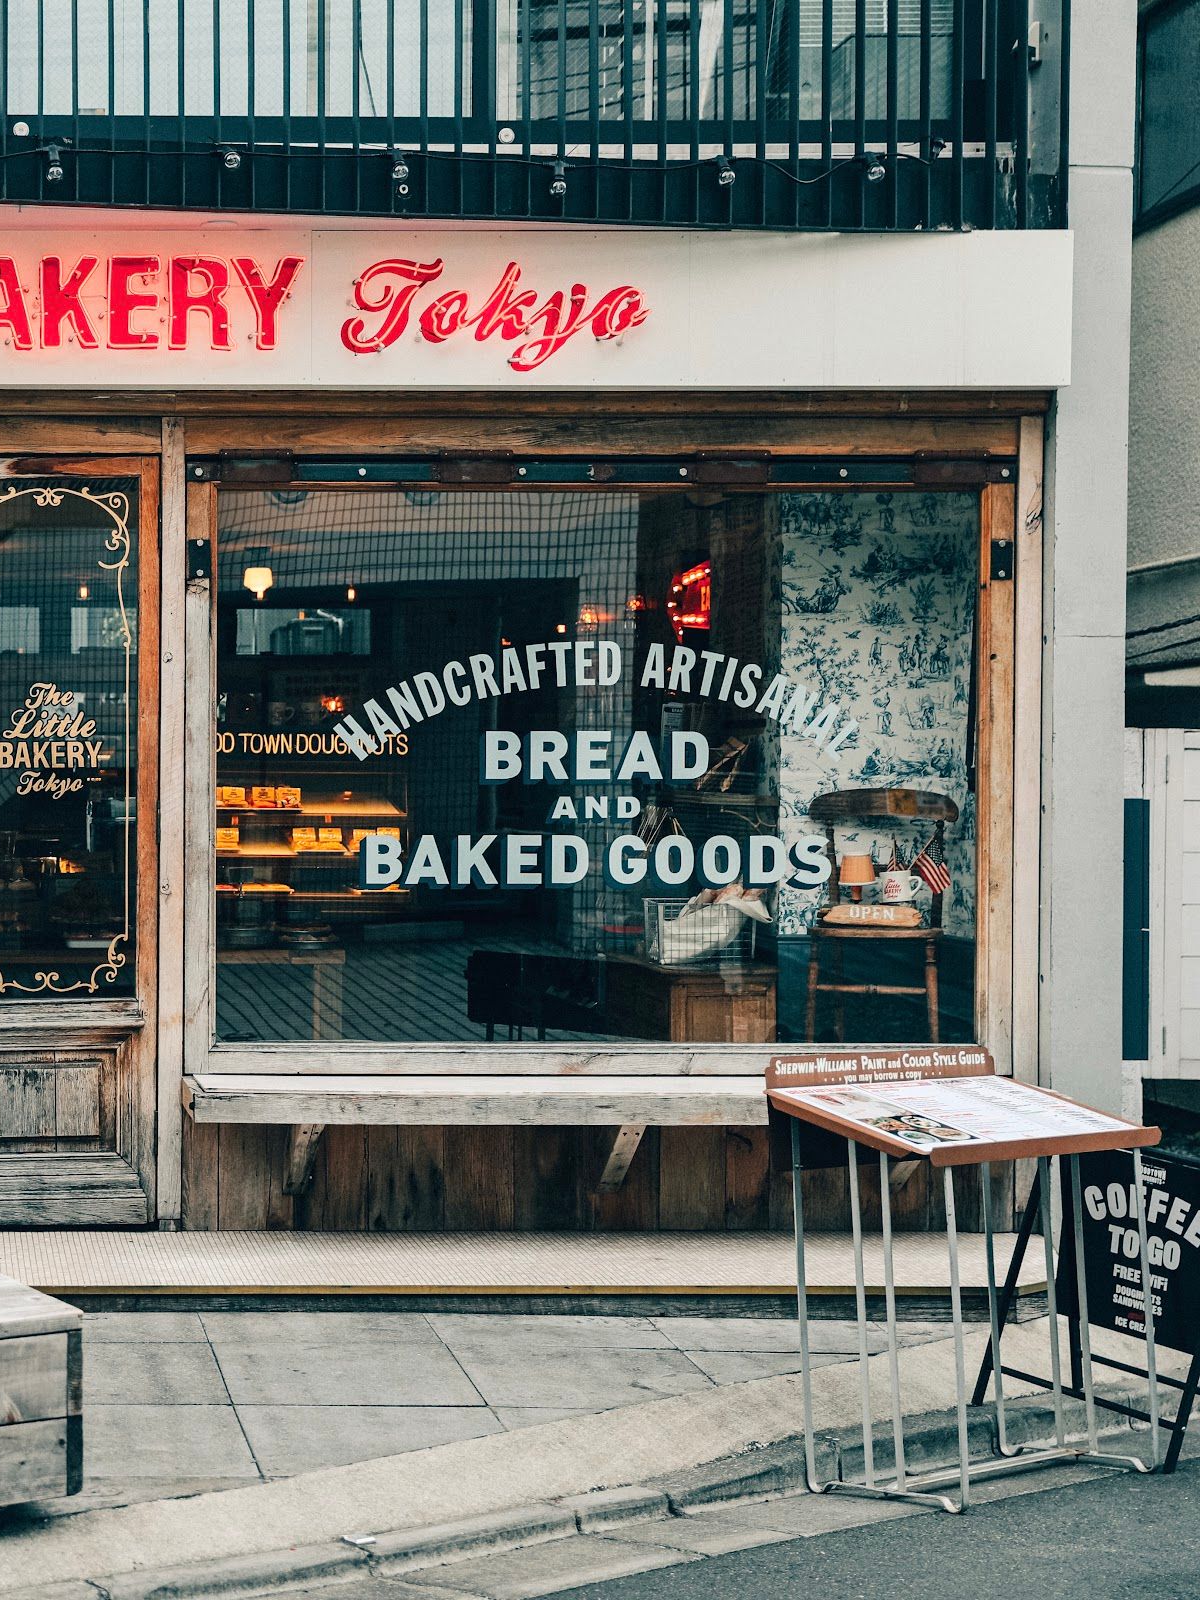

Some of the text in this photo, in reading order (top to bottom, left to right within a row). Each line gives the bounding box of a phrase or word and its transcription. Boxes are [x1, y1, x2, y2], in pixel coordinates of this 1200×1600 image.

[340, 257, 649, 372] Tokyo
[25, 682, 75, 709] The
[332, 640, 860, 763] HANDCRAFTED ARTISANAL
[2, 708, 97, 739] Little
[238, 732, 293, 754] TOWN
[296, 732, 409, 756] DOUGUTS
[484, 730, 711, 781] BREAD
[16, 770, 84, 800] Tokyo
[550, 795, 642, 821] AND
[362, 834, 834, 887] BAKED GOODS
[849, 905, 895, 921] OPEN
[861, 1055, 887, 1070] PAINT
[887, 1058, 901, 1069] and
[902, 1053, 932, 1068] COLOR
[932, 1052, 957, 1066] STYLE
[958, 1051, 986, 1064] GUIDE
[844, 1074, 857, 1085] you
[858, 1073, 873, 1083] may
[873, 1071, 899, 1080] borrow
[905, 1070, 922, 1081] copy
[1084, 1182, 1200, 1249] COFFEE
[1108, 1223, 1181, 1271] TO GO
[1112, 1263, 1142, 1284] FREE
[1112, 1293, 1163, 1317] SANDWIES
[1115, 1284, 1162, 1306] DOUGHTS
[1114, 1315, 1129, 1328] ICE
